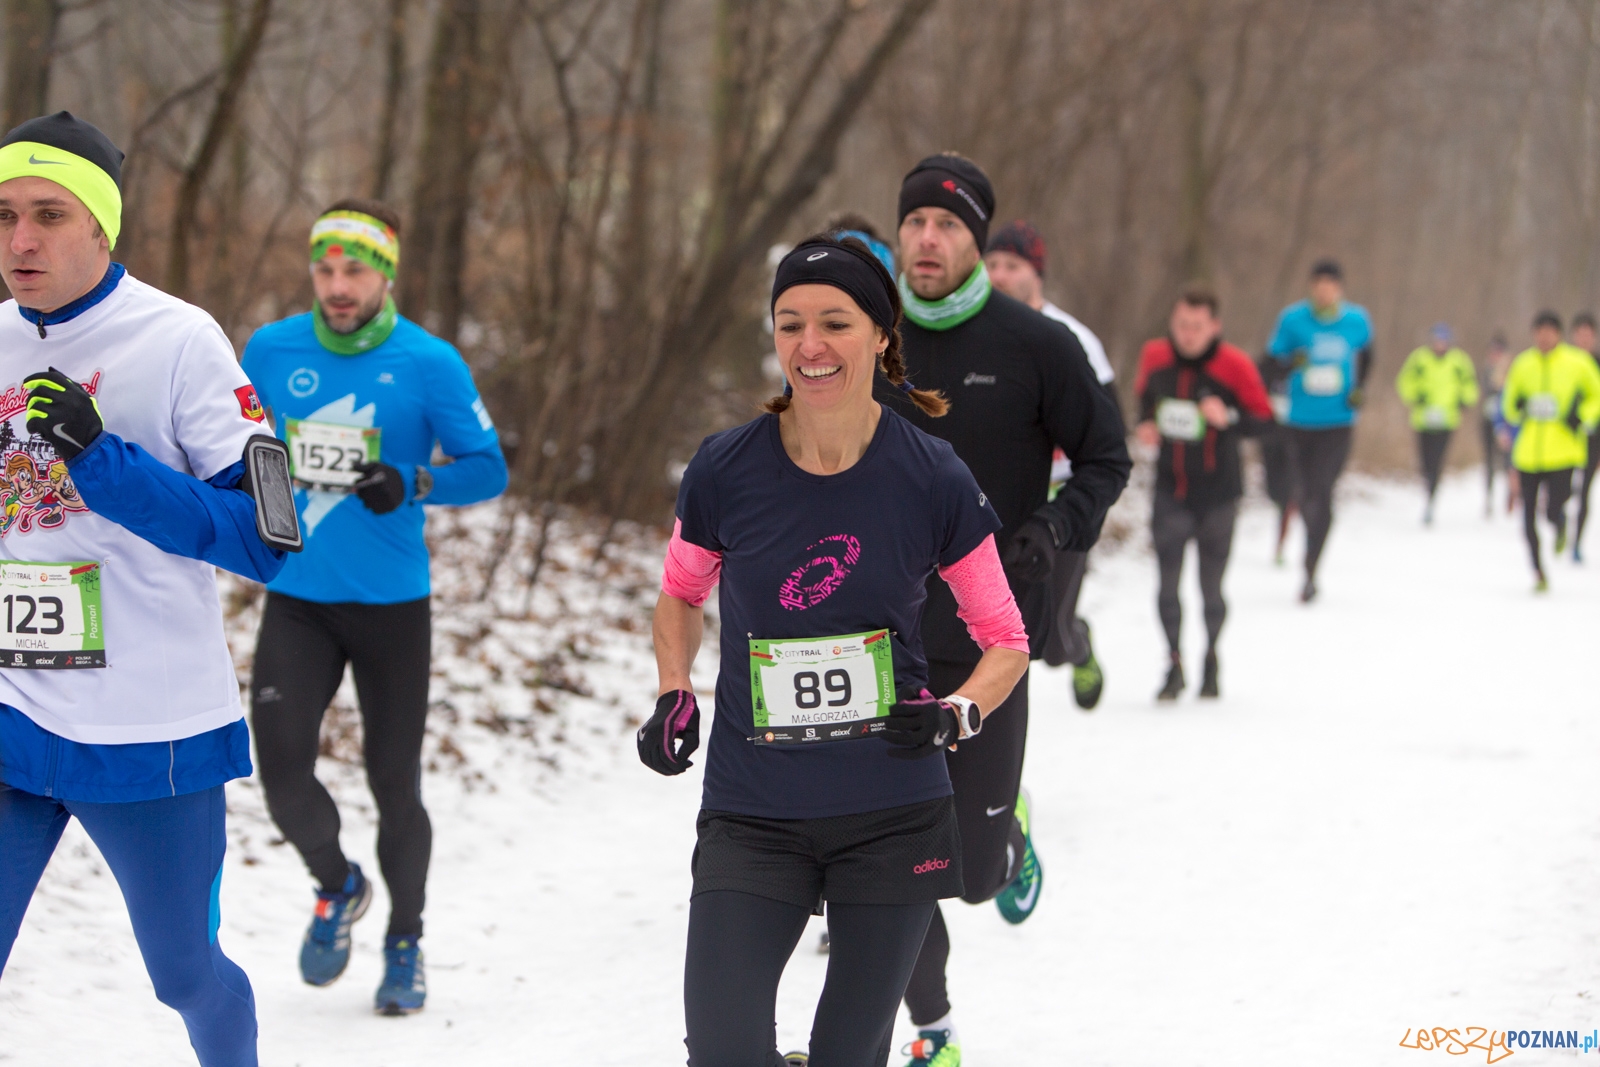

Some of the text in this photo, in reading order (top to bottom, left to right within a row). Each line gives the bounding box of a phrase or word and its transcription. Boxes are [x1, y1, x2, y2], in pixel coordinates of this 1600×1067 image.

[3, 594, 65, 635] 123
[87, 604, 99, 639] Poznań
[15, 638, 50, 650] MICHAŁ
[793, 668, 852, 709] 89
[882, 670, 891, 705] Poznań
[791, 709, 860, 724] MAŁGORZATA
[913, 857, 950, 874] adidas
